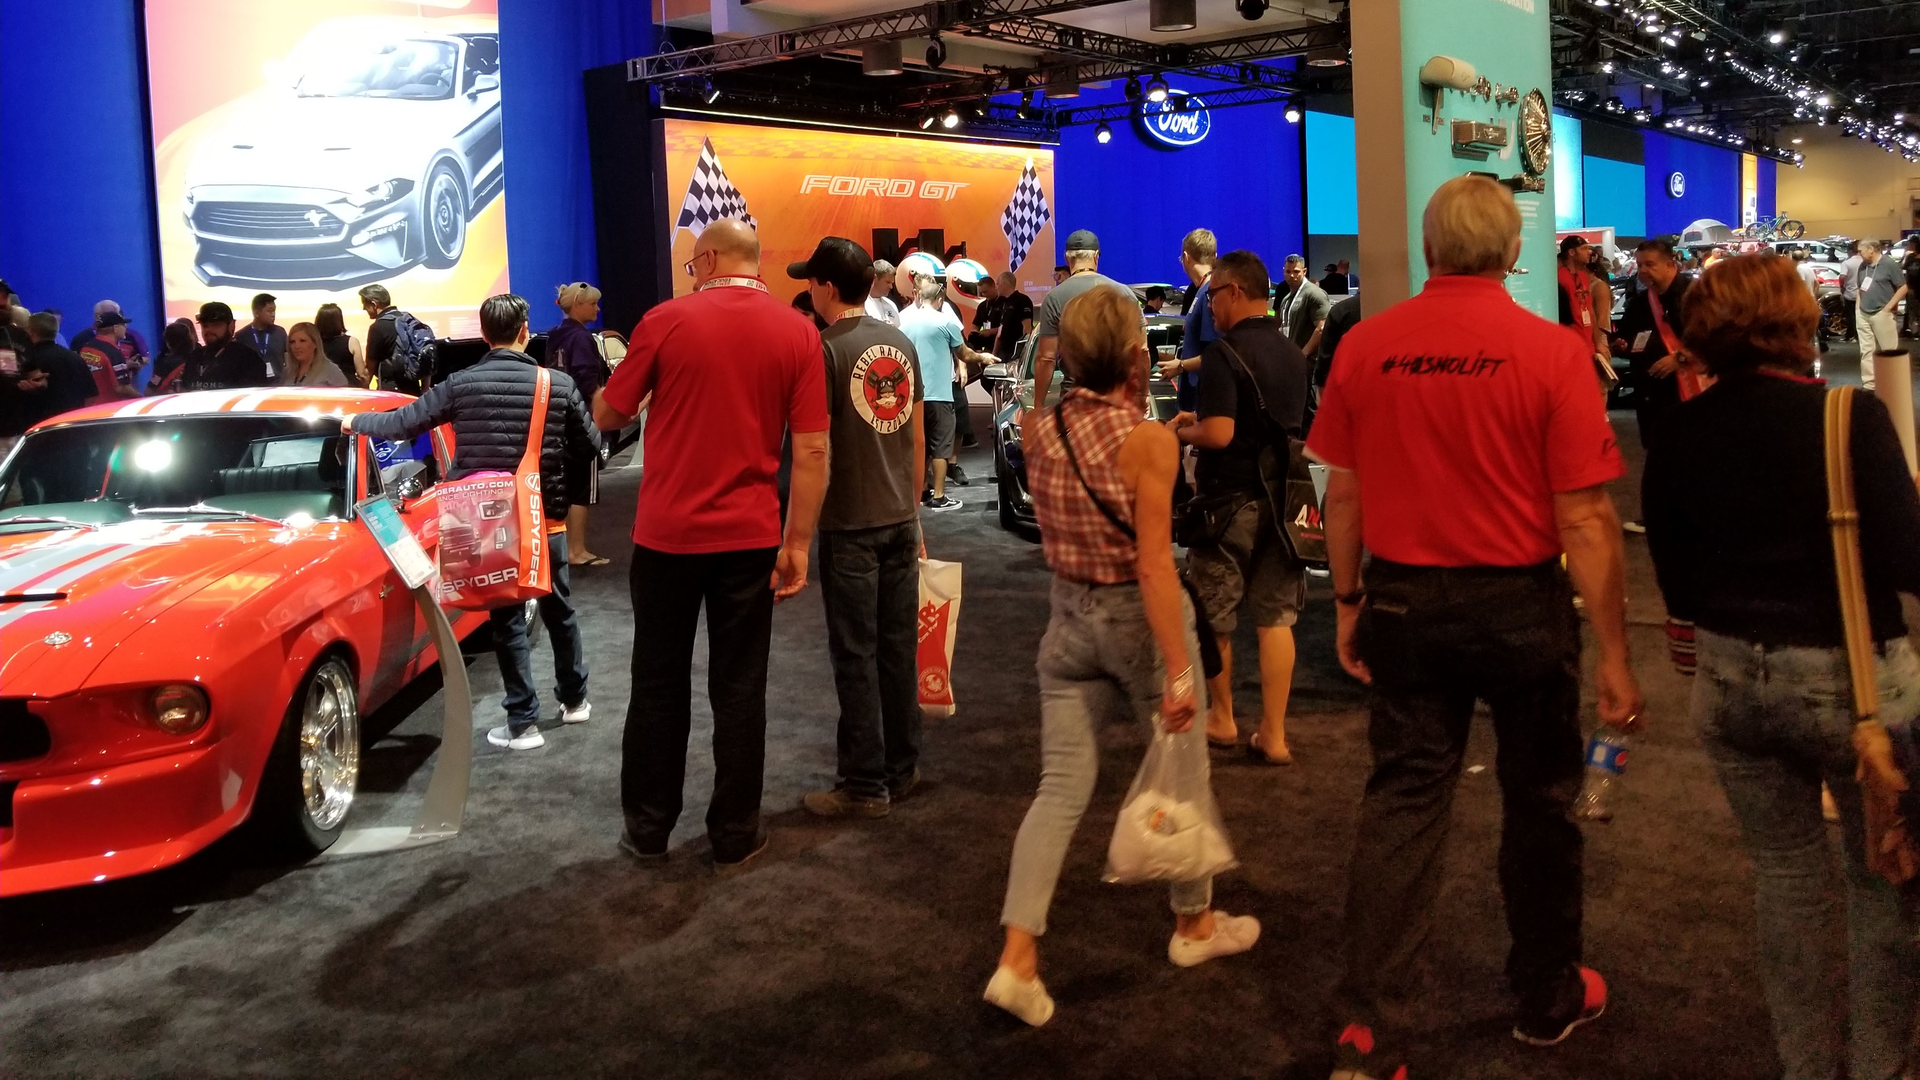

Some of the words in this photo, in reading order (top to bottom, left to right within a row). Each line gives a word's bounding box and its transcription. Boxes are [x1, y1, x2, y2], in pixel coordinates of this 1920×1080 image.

[1158, 99, 1200, 135] Ford
[799, 174, 916, 198] FORD
[918, 180, 970, 201] GT
[853, 348, 877, 380] REBEL
[880, 346, 911, 374] RACING
[462, 488, 505, 498] LIGHTING
[528, 494, 541, 587] SPYDER
[442, 567, 519, 594] SPYDER
